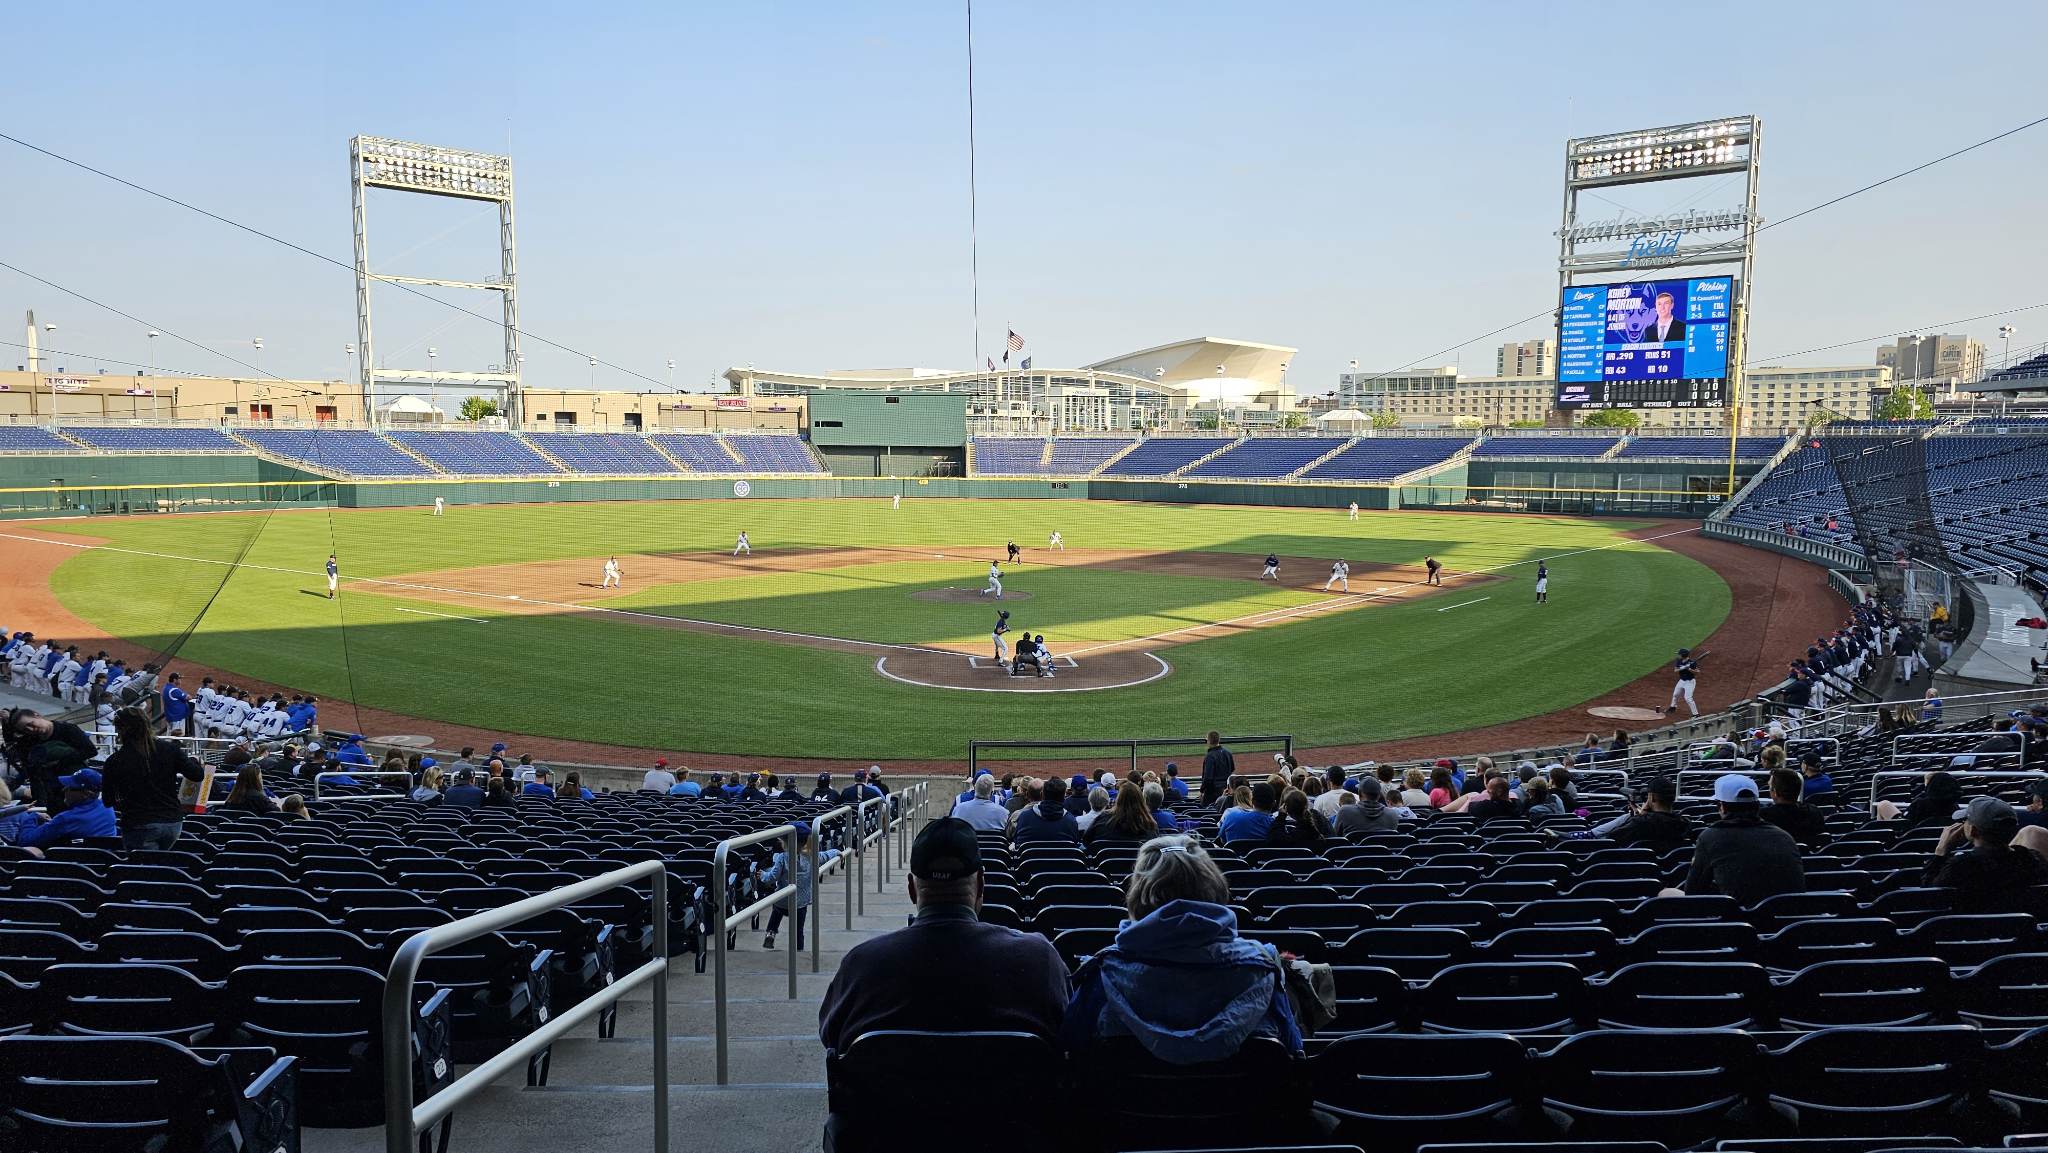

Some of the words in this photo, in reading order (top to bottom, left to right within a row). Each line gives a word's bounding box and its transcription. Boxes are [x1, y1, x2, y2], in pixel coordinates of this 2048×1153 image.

[1620, 231, 1680, 266] field
[1692, 383, 1698, 391] 0
[1713, 383, 1718, 391] 0
[1603, 393, 1609, 401] 0
[263, 717, 277, 727] 44
